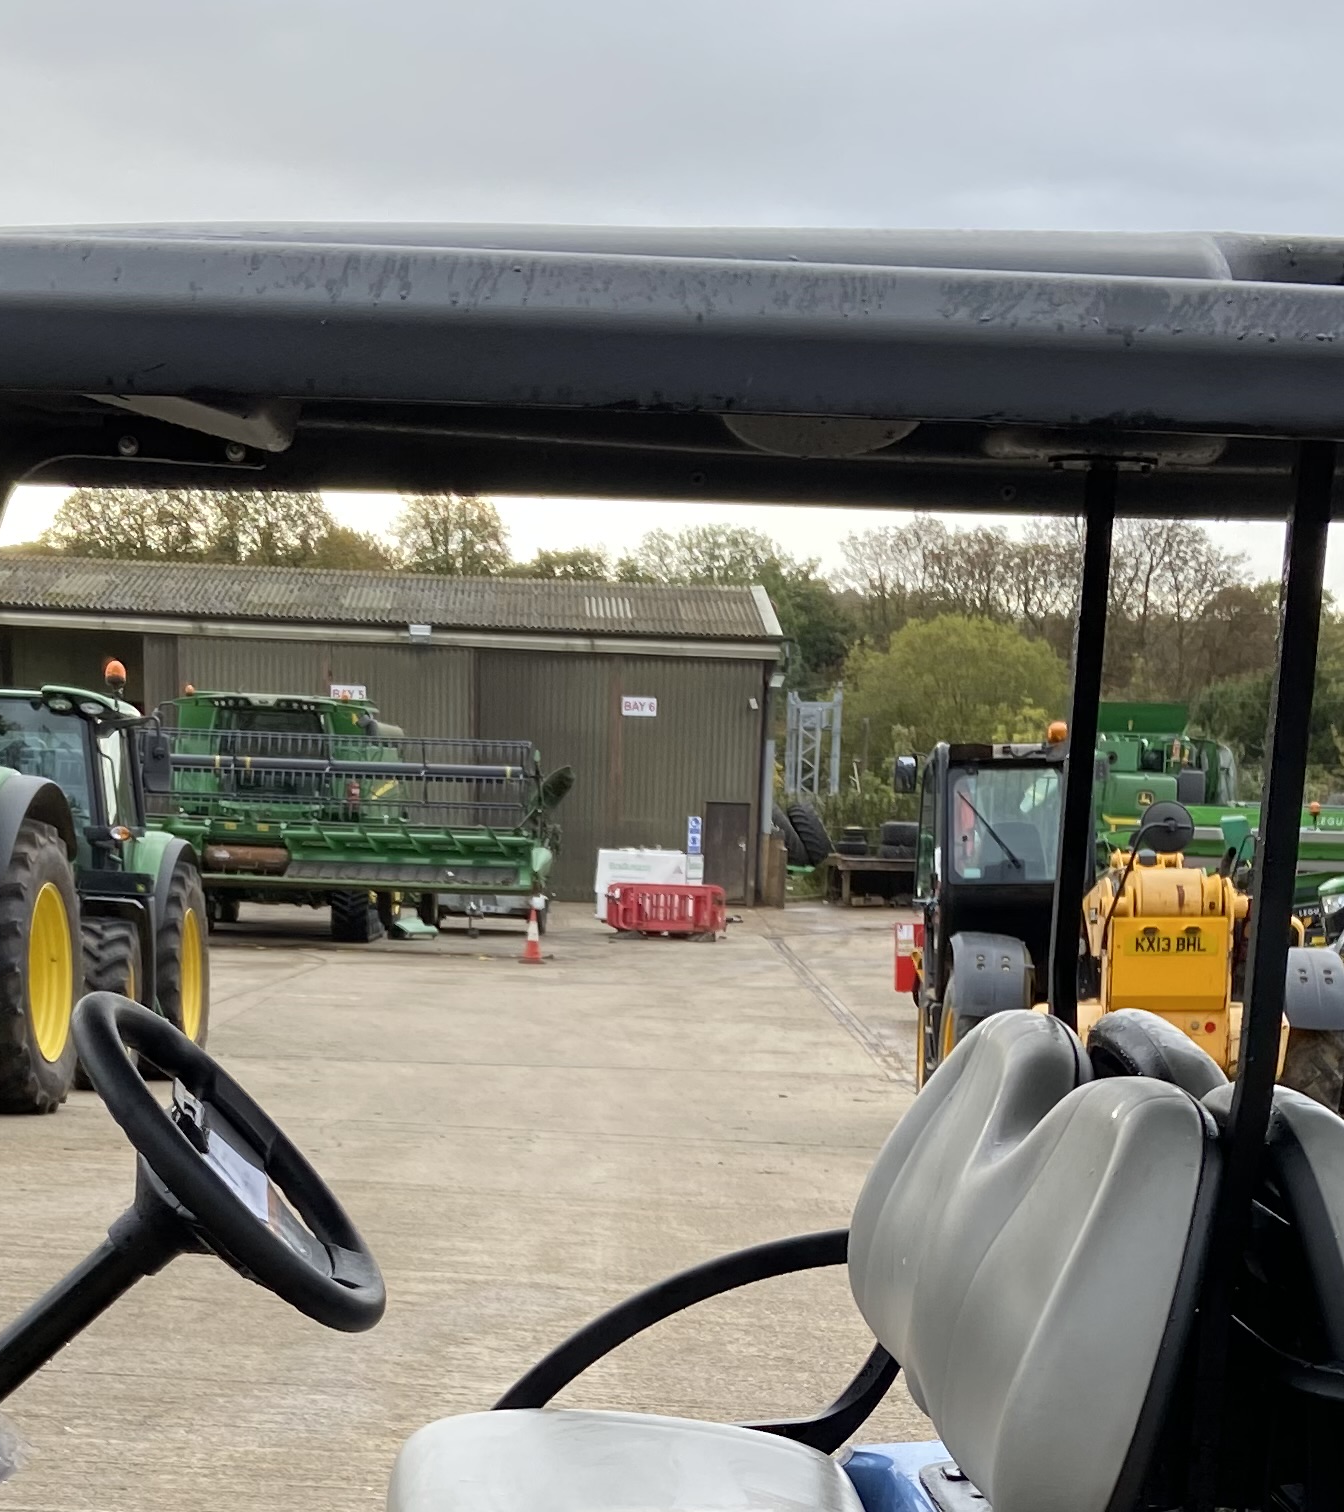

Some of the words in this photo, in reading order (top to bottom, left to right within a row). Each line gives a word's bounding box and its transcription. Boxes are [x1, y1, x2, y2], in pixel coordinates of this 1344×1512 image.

[359, 690, 364, 699] 5
[624, 701, 646, 712] BAY
[648, 701, 656, 713] 6
[1136, 937, 1171, 952] KX13
[1176, 937, 1207, 952] BHL
